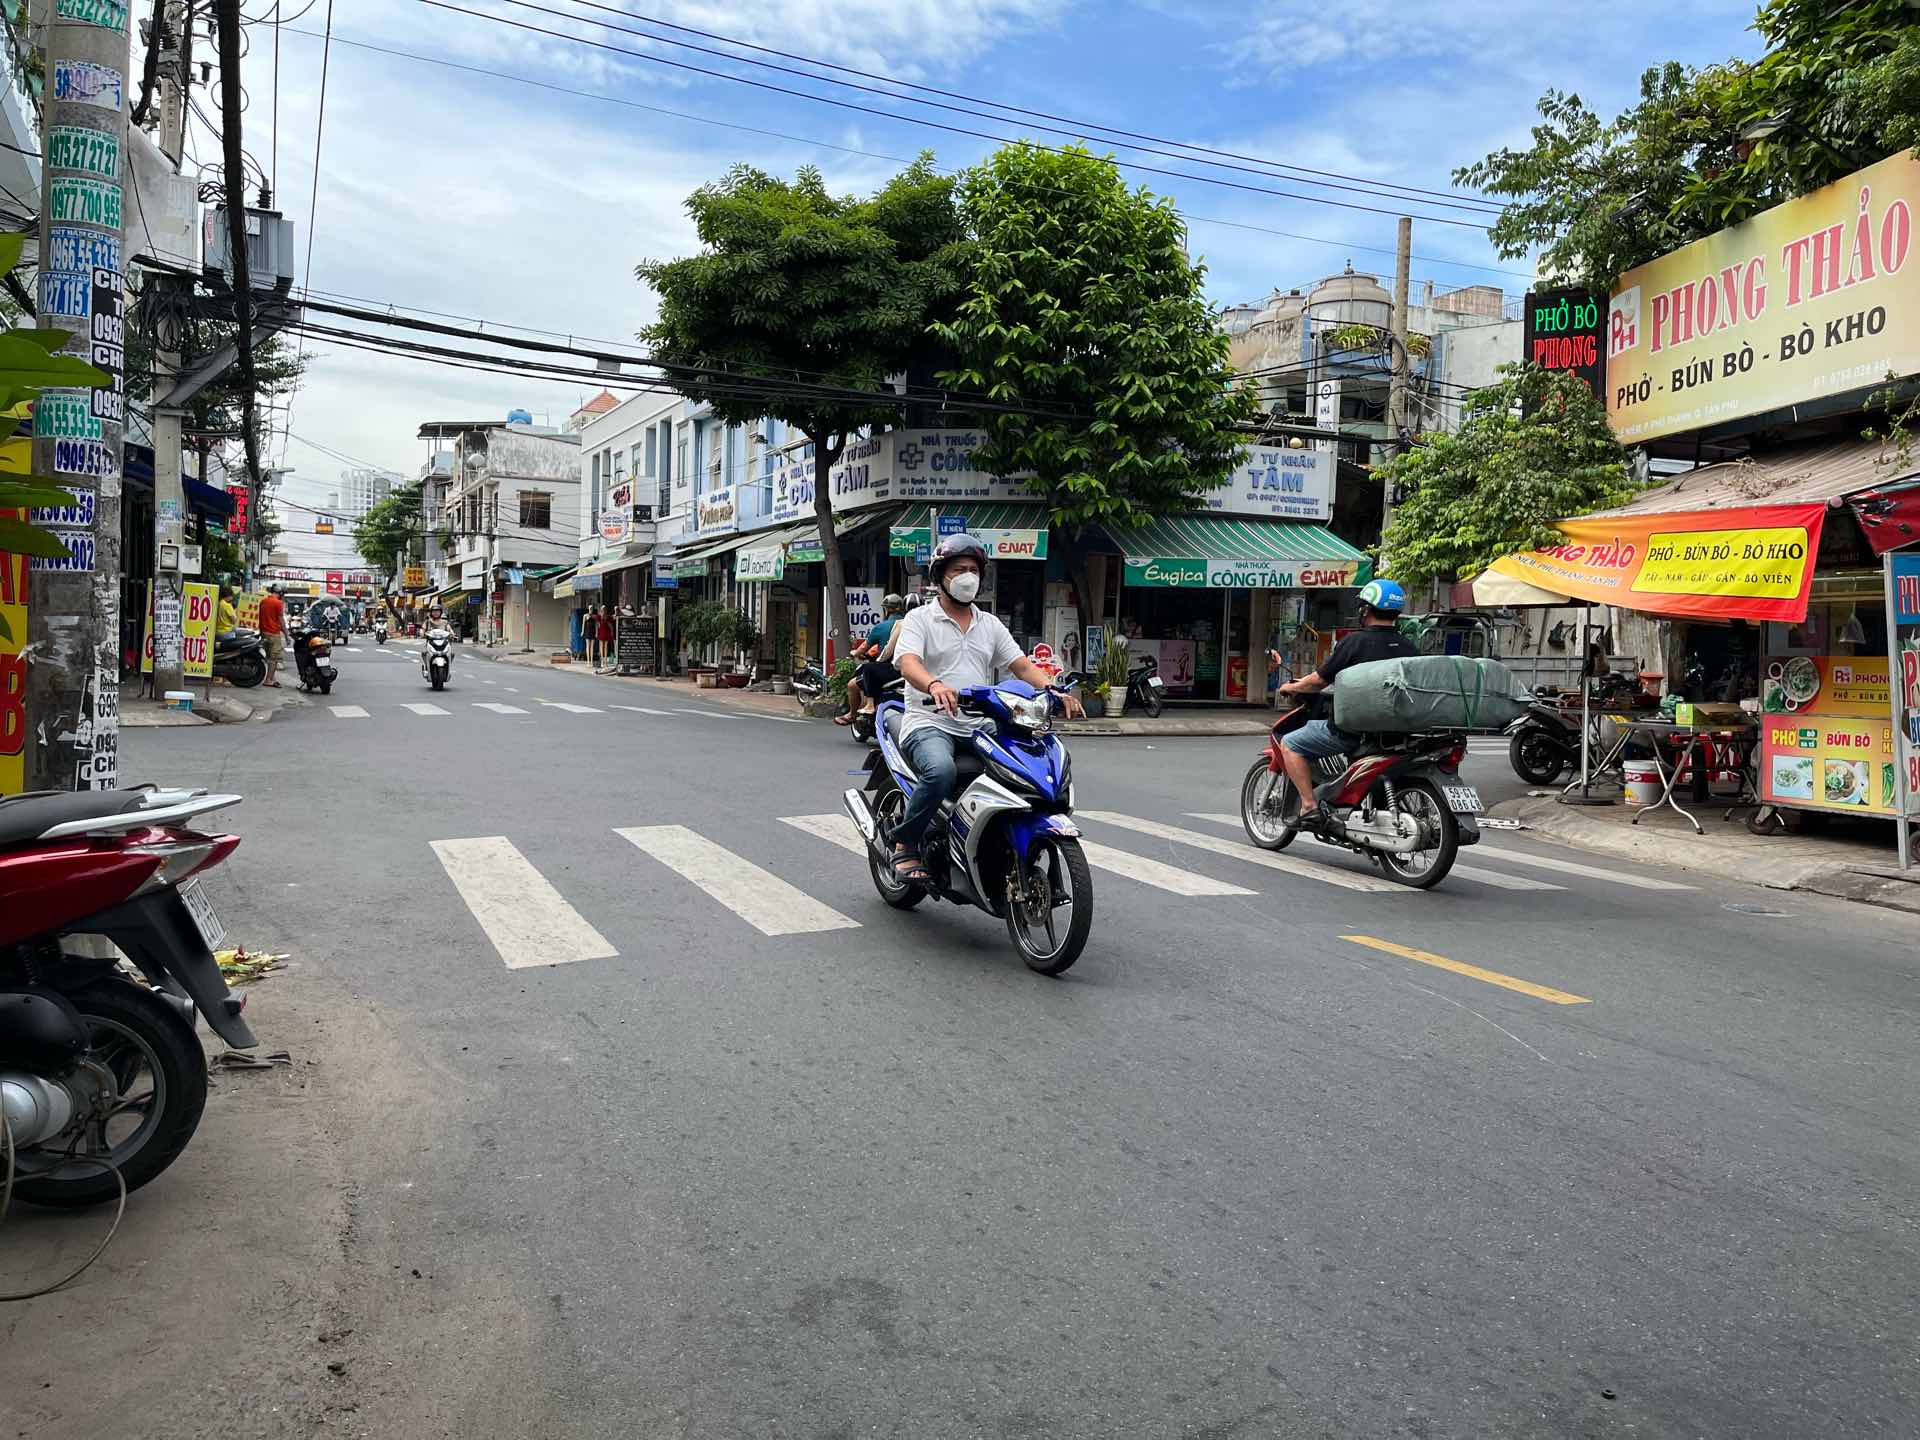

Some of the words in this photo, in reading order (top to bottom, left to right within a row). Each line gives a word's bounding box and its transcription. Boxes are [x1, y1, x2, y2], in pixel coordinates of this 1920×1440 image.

[52, 187, 119, 228] 0977.700.955
[1650, 254, 1767, 353] PHONG
[1781, 185, 1911, 307] THẢO
[1535, 298, 1569, 332] PHỞ
[1573, 296, 1598, 329] BÒ
[1533, 335, 1597, 369] PHONG
[1617, 371, 1653, 410] PHỞ
[1671, 356, 1714, 393] BÚN
[1722, 341, 1754, 378] BÒ
[1780, 322, 1815, 362] BÒ
[1824, 305, 1887, 349] KHO
[832, 464, 869, 496] TÂM
[1247, 464, 1305, 493] TÂM
[997, 542, 1036, 554] ENAT
[1583, 536, 1636, 568] THẢO
[1647, 541, 1674, 561] PHỞ
[1683, 542, 1710, 561] BÚN
[1711, 541, 1731, 560] BÒ
[1742, 540, 1764, 560] BÒ
[1766, 543, 1804, 560] KHO
[1143, 565, 1204, 586] Eugica
[1211, 569, 1257, 587] CÔNG
[1258, 570, 1294, 587] TÂM
[1299, 570, 1348, 586] ENAT
[1771, 725, 1798, 747] PHỞ
[1826, 730, 1851, 747] BÚN
[1854, 732, 1871, 748] BÒ
